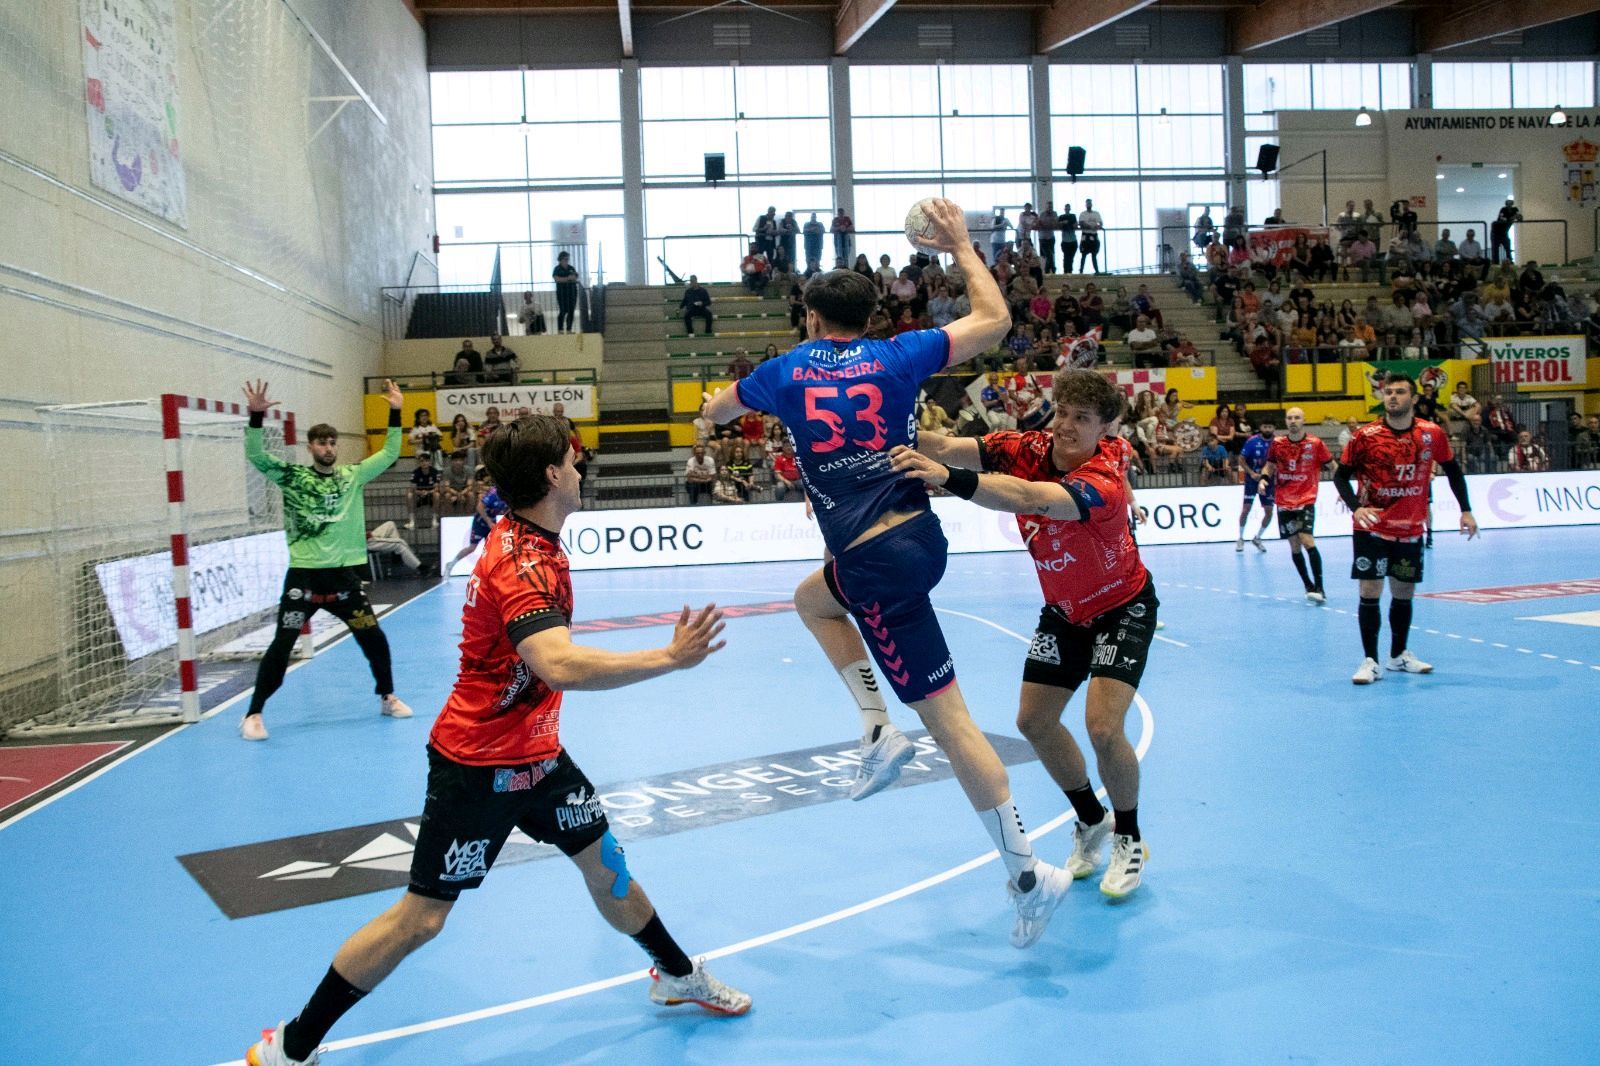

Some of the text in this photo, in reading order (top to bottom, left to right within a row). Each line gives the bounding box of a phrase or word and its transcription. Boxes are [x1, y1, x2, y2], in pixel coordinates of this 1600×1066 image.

[1405, 116, 1496, 130] AYUNTAMIENTO
[1500, 116, 1514, 129] DE
[1518, 115, 1556, 128] NAVA
[1558, 115, 1573, 128] E
[1576, 115, 1590, 128] LA
[1495, 345, 1570, 359] VIVEROS
[792, 358, 886, 381] BANDEIRA
[1495, 359, 1572, 383] HEROL
[447, 388, 584, 405] CASTILLA Y LEÓN
[501, 407, 552, 418] IMPLS
[804, 383, 889, 453] 53
[1395, 464, 1416, 481] 73
[1131, 502, 1222, 530] PORC
[559, 523, 704, 555] NOPORC
[1035, 552, 1077, 572] NCA
[1029, 639, 1061, 660] EGA
[928, 655, 953, 683] HUER
[614, 757, 950, 828] DE SEGVI
